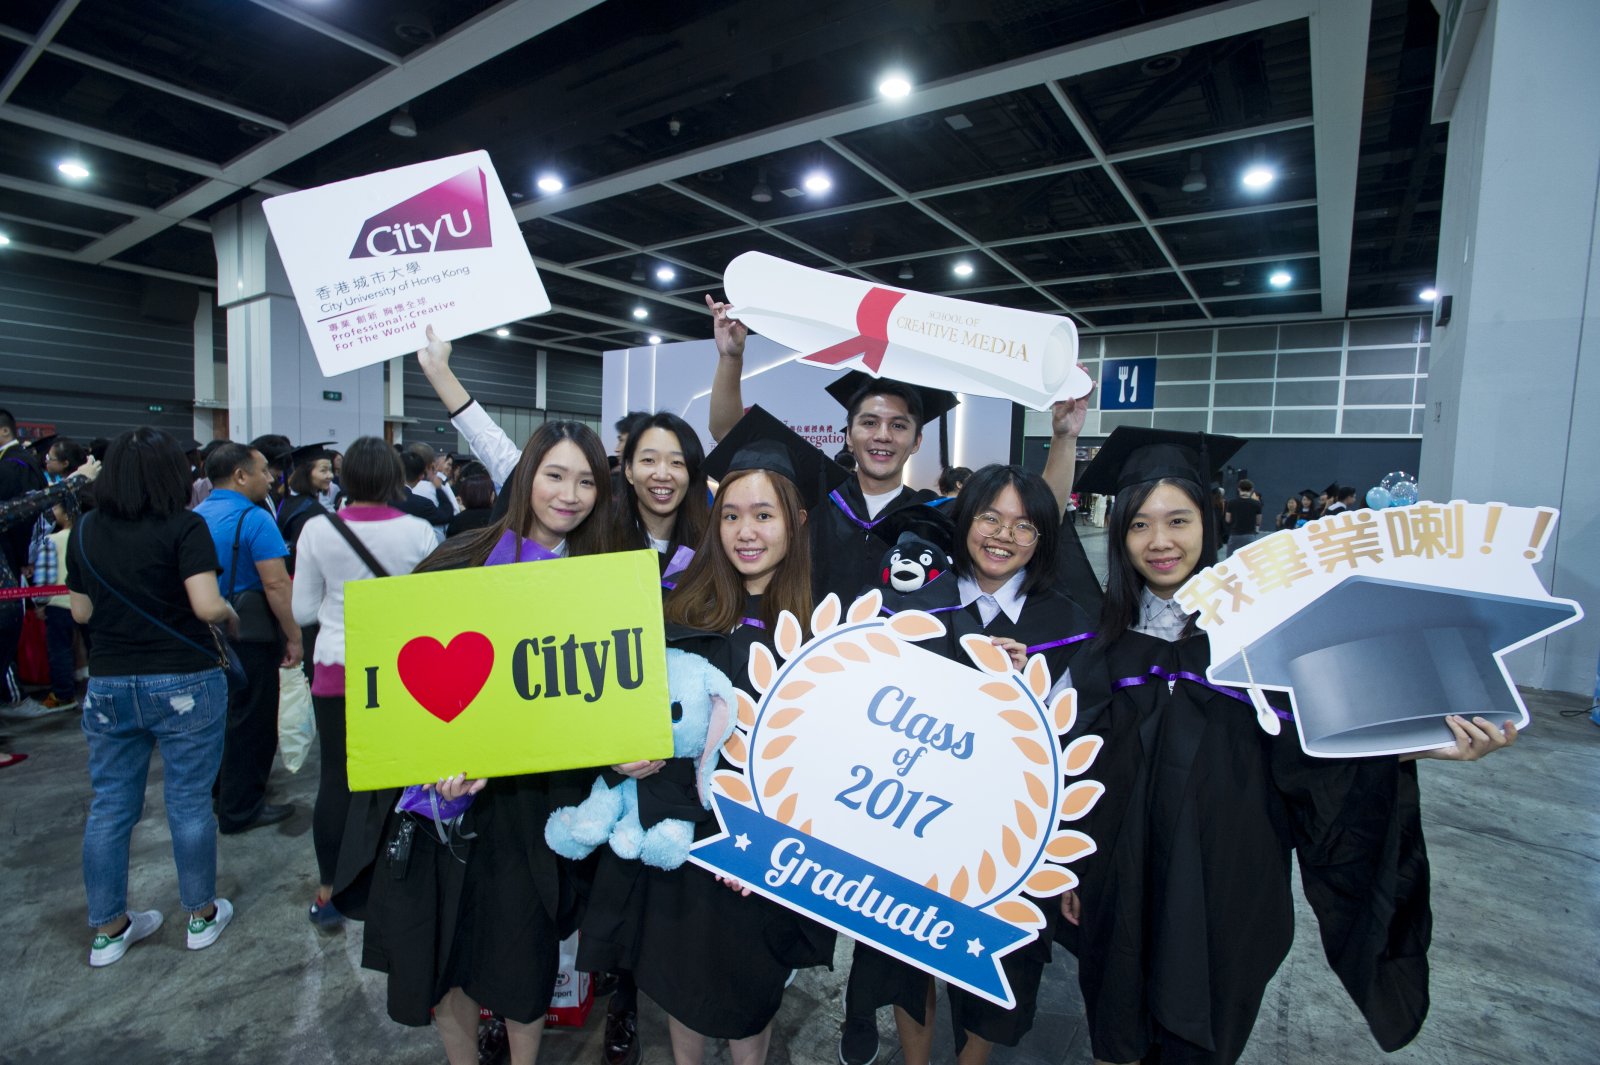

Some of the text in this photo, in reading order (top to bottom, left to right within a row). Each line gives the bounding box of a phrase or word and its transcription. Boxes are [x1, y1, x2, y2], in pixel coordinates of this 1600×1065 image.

[366, 209, 473, 257] CityU
[315, 261, 422, 301] 香港城市大學
[320, 266, 470, 313] City University of Hong Kong
[335, 321, 417, 351] For The World
[896, 316, 1030, 362] CREATIVE MEDIA
[929, 311, 981, 327] SCHOOL OF
[801, 432, 844, 448] regatio
[364, 627, 644, 709] I CityU
[866, 685, 976, 761] Class
[892, 746, 929, 777] of
[834, 764, 954, 839] 2017
[764, 837, 956, 951] Graduate
